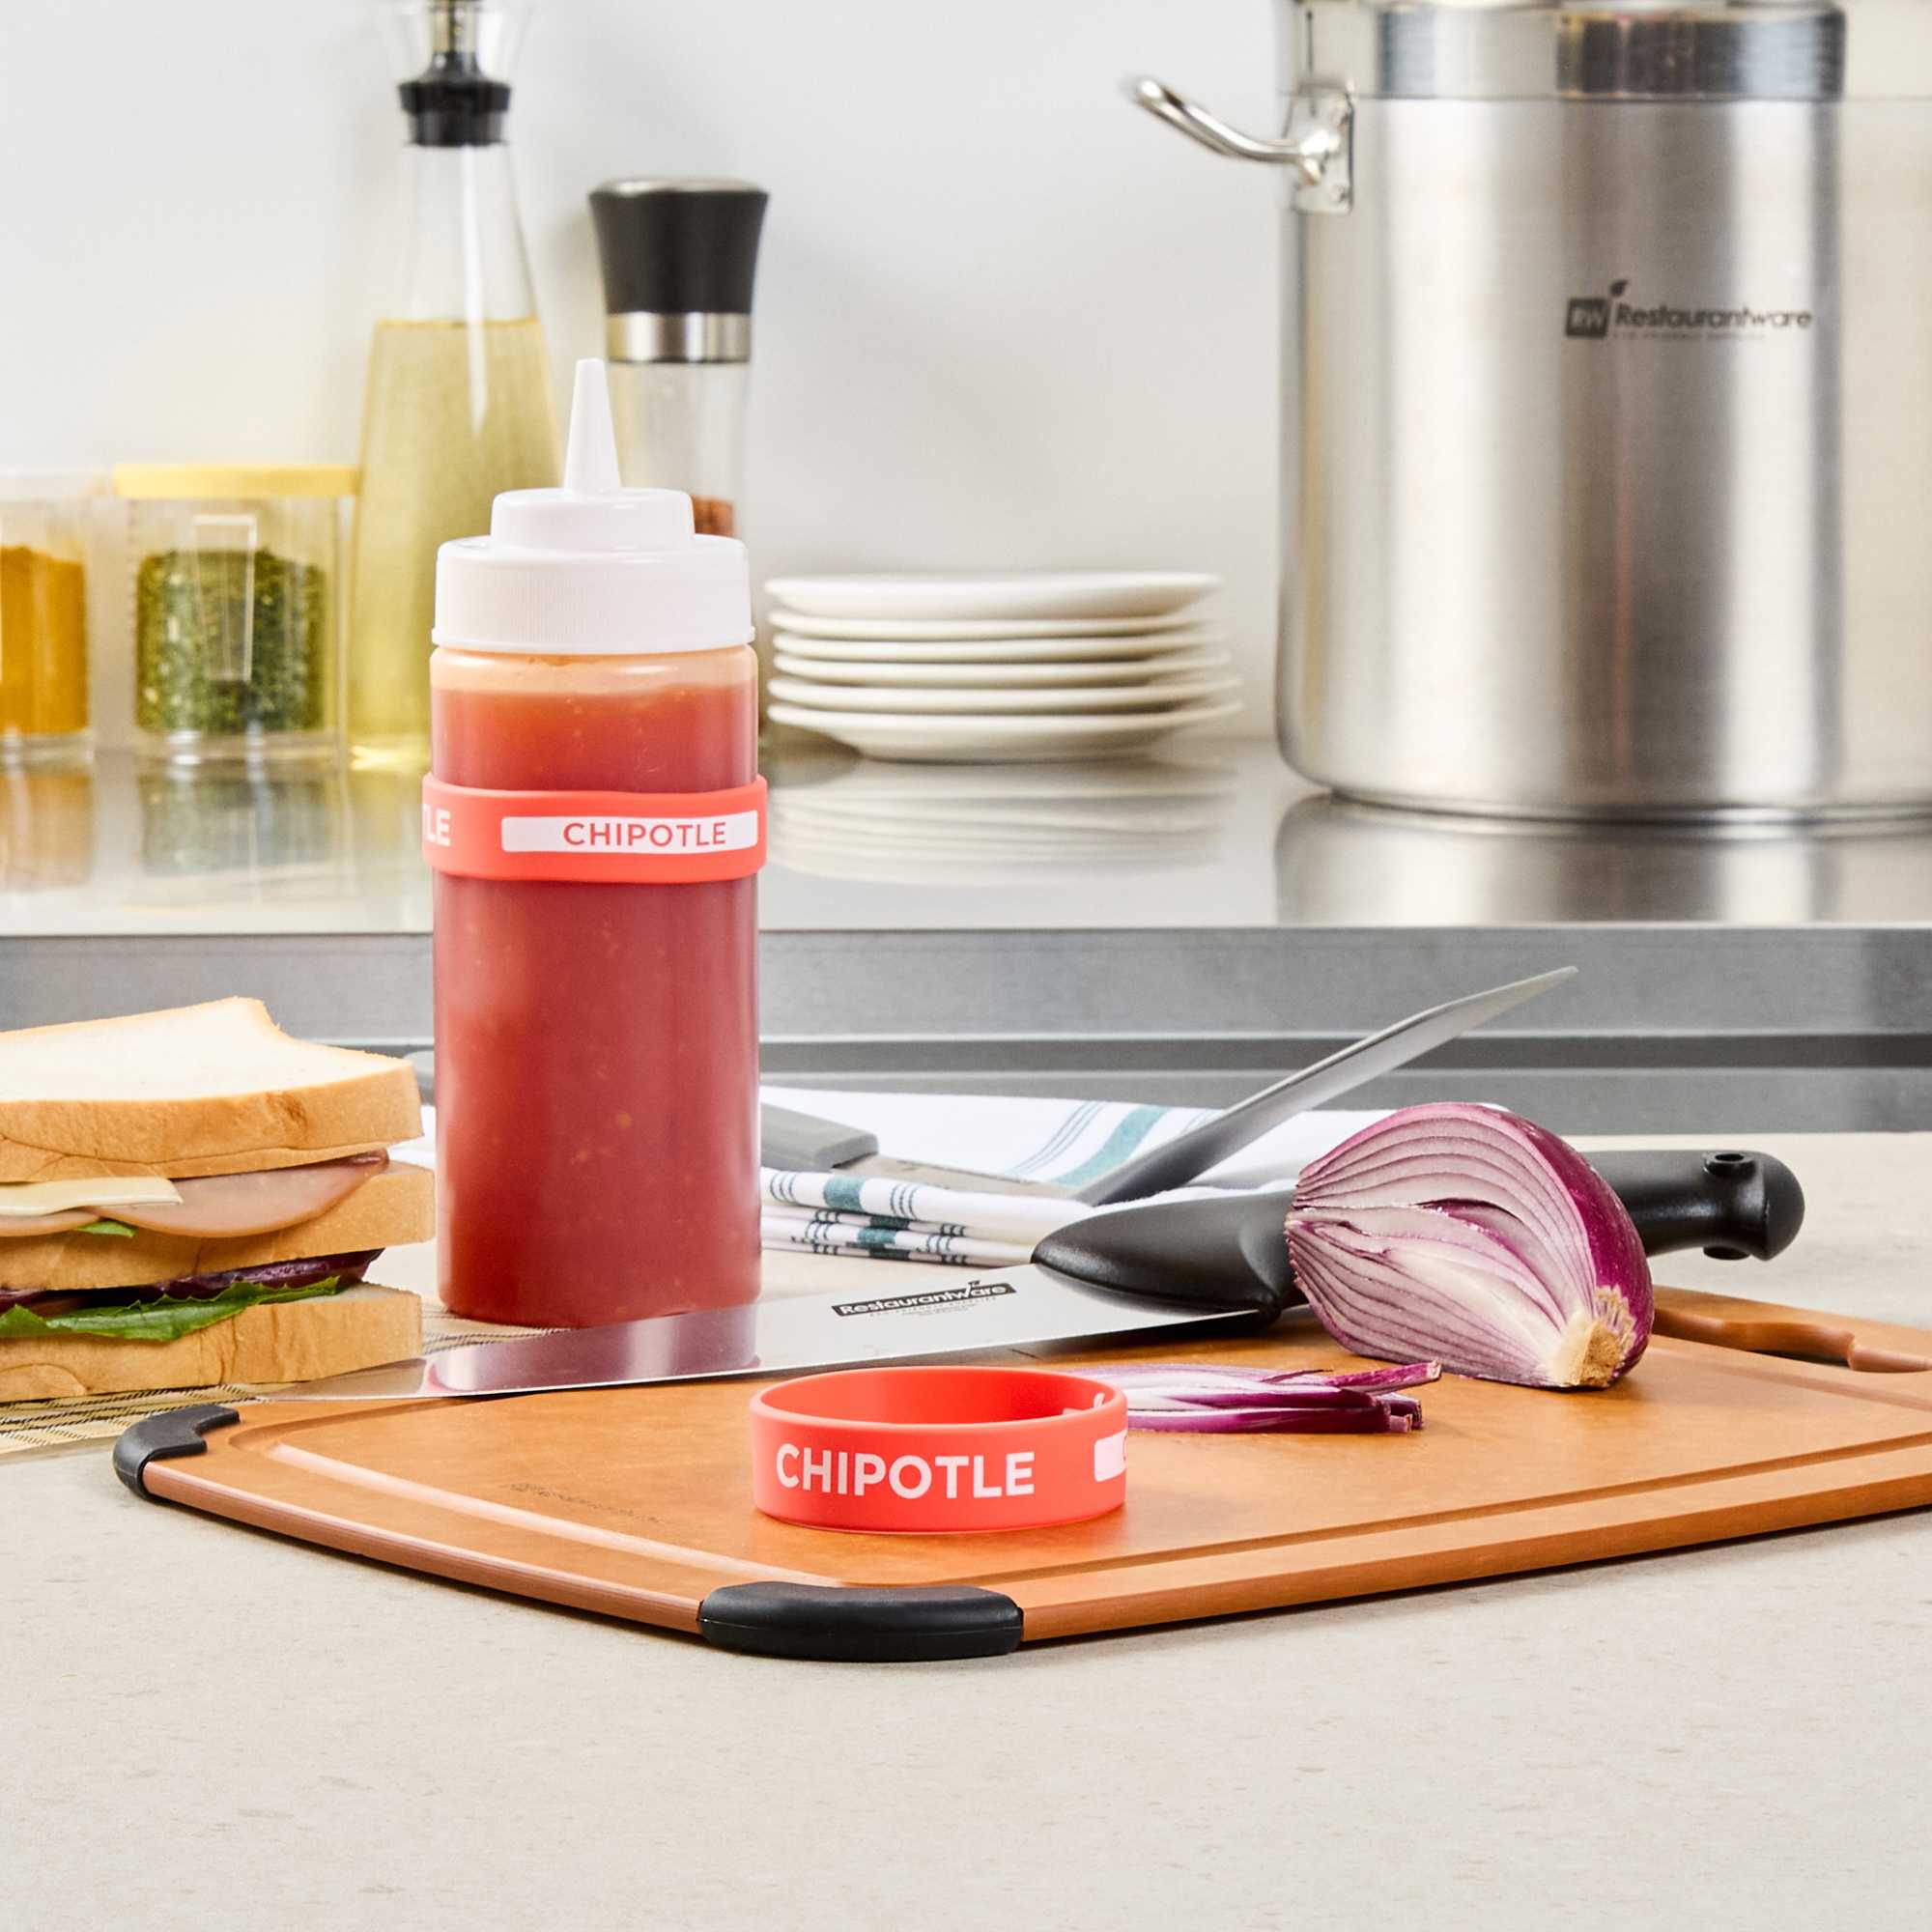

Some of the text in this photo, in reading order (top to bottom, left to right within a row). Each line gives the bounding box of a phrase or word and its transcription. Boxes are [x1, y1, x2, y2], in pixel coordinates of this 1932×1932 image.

[1615, 302, 1812, 327] Restaurantware
[563, 822, 725, 847] CHIPOTLE
[776, 1443, 1035, 1499] CHIPOTLE
